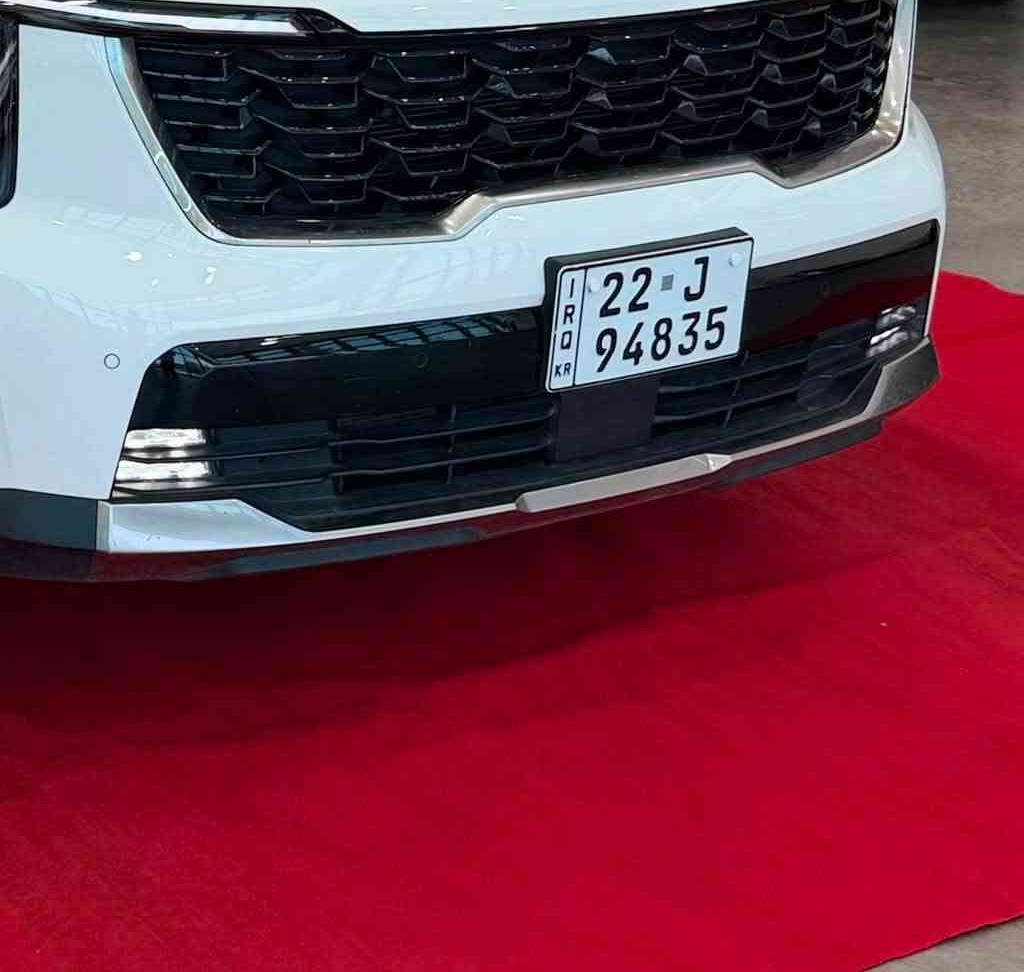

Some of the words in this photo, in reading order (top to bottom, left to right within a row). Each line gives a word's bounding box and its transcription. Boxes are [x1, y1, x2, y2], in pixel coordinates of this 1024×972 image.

[599, 267, 652, 318] 22
[683, 256, 710, 302] J
[595, 306, 729, 373] 94835
